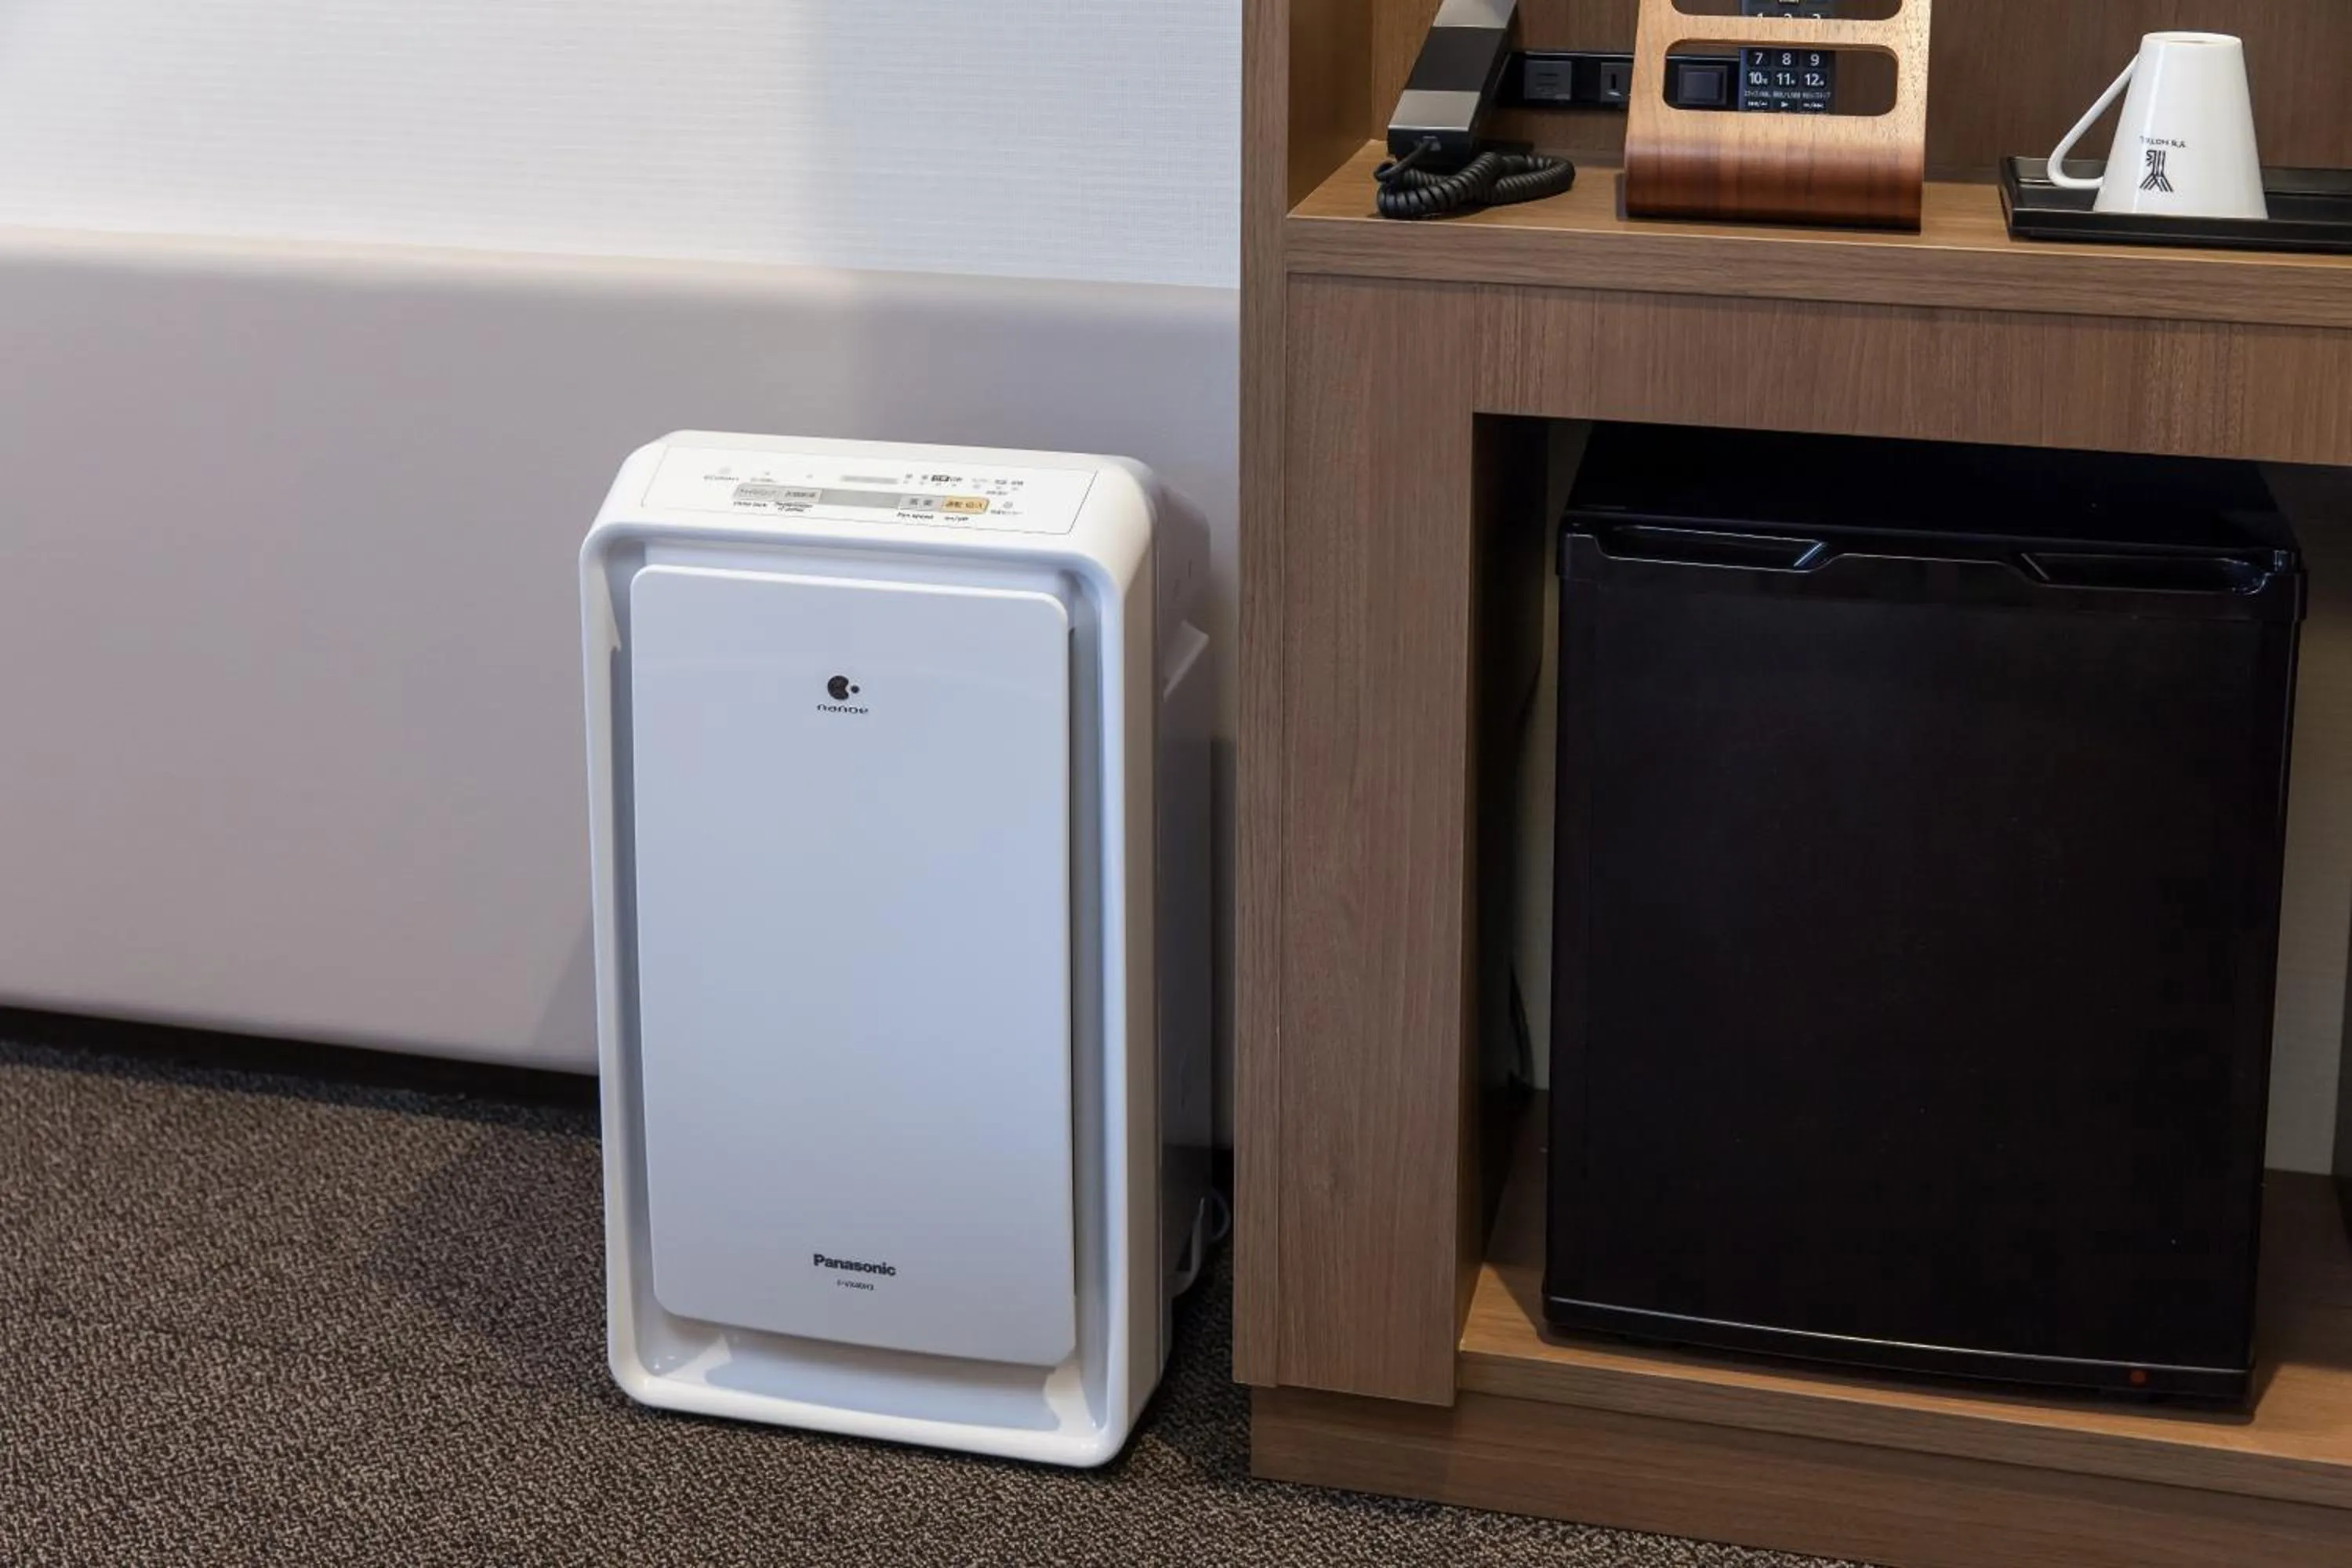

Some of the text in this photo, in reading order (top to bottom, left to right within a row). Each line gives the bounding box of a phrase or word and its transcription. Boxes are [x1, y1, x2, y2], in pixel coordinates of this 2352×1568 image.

[1755, 52, 1820, 67] 7 8 9
[813, 1254, 897, 1276] Panasonic
